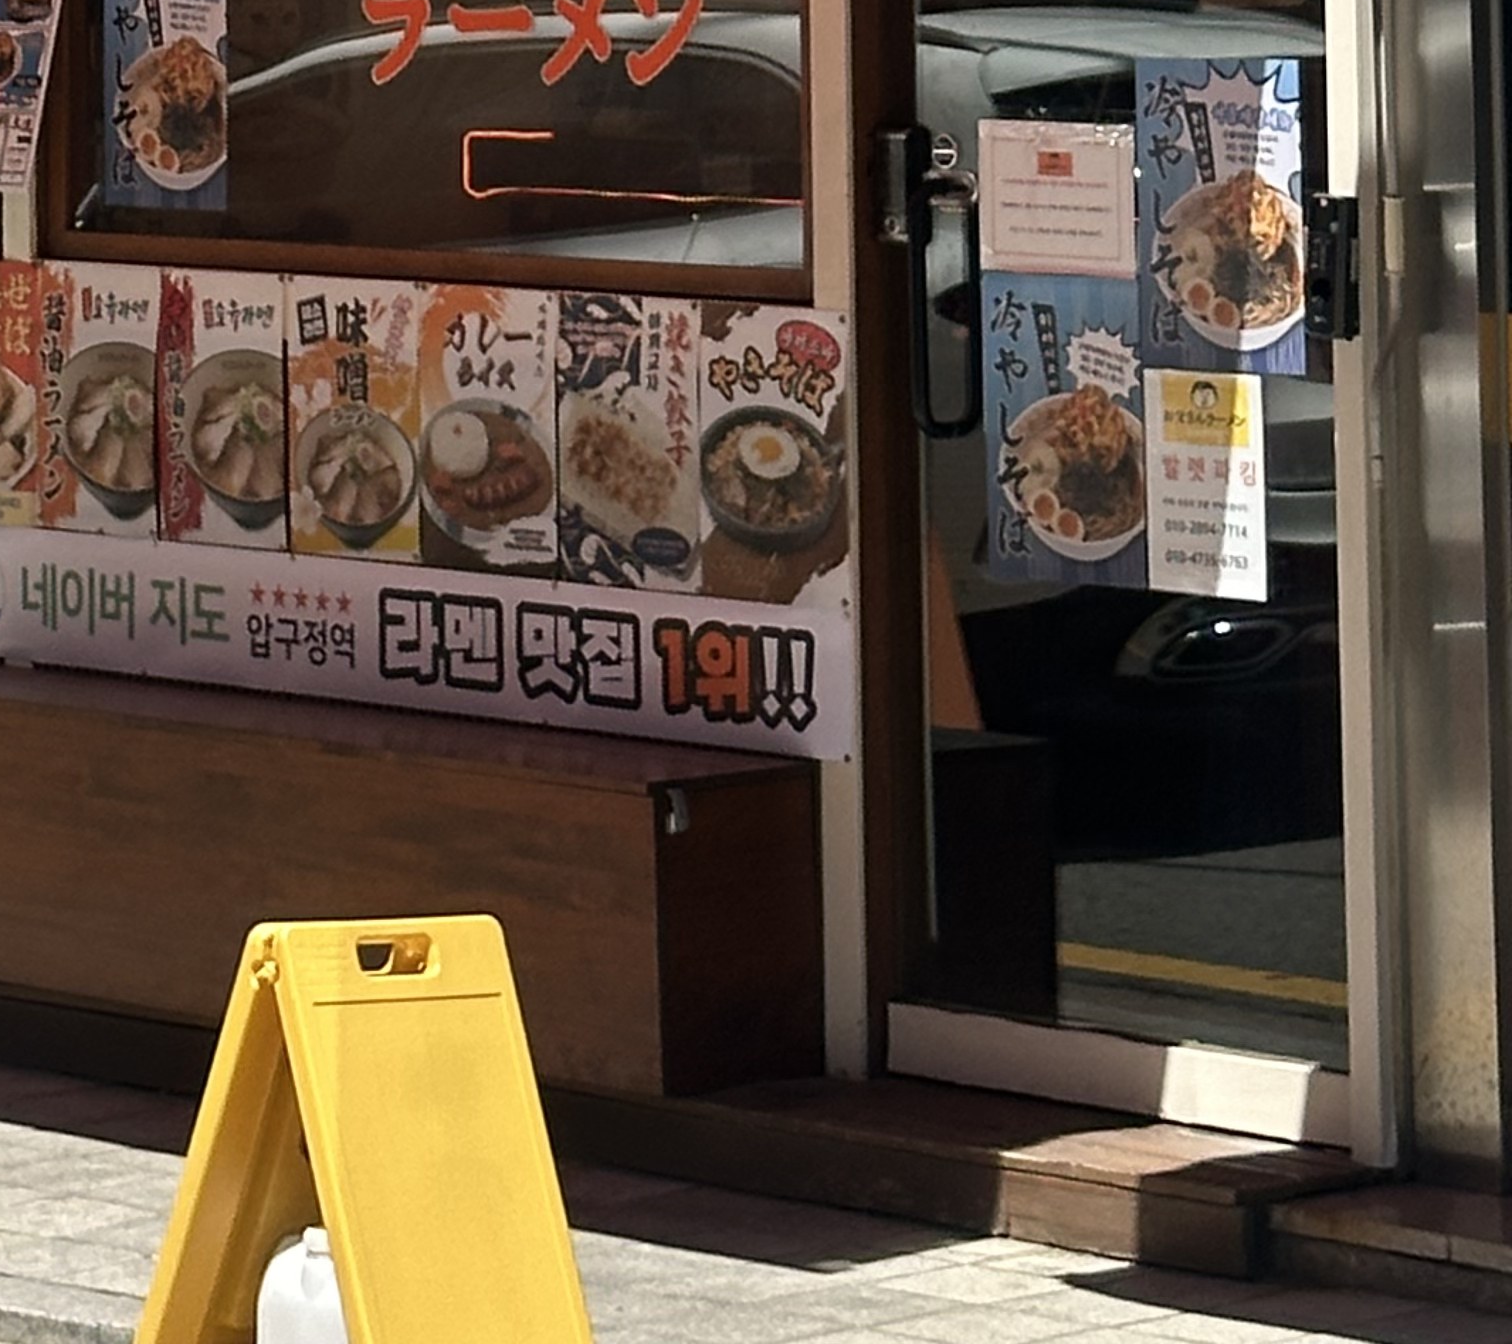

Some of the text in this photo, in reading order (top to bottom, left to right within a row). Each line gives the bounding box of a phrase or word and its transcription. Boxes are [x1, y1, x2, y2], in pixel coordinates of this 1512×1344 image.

[20, 562, 232, 647] 네이버 지도
[245, 613, 357, 670] 압구정역
[379, 588, 819, 733] 라멘 맛집 1위!!
